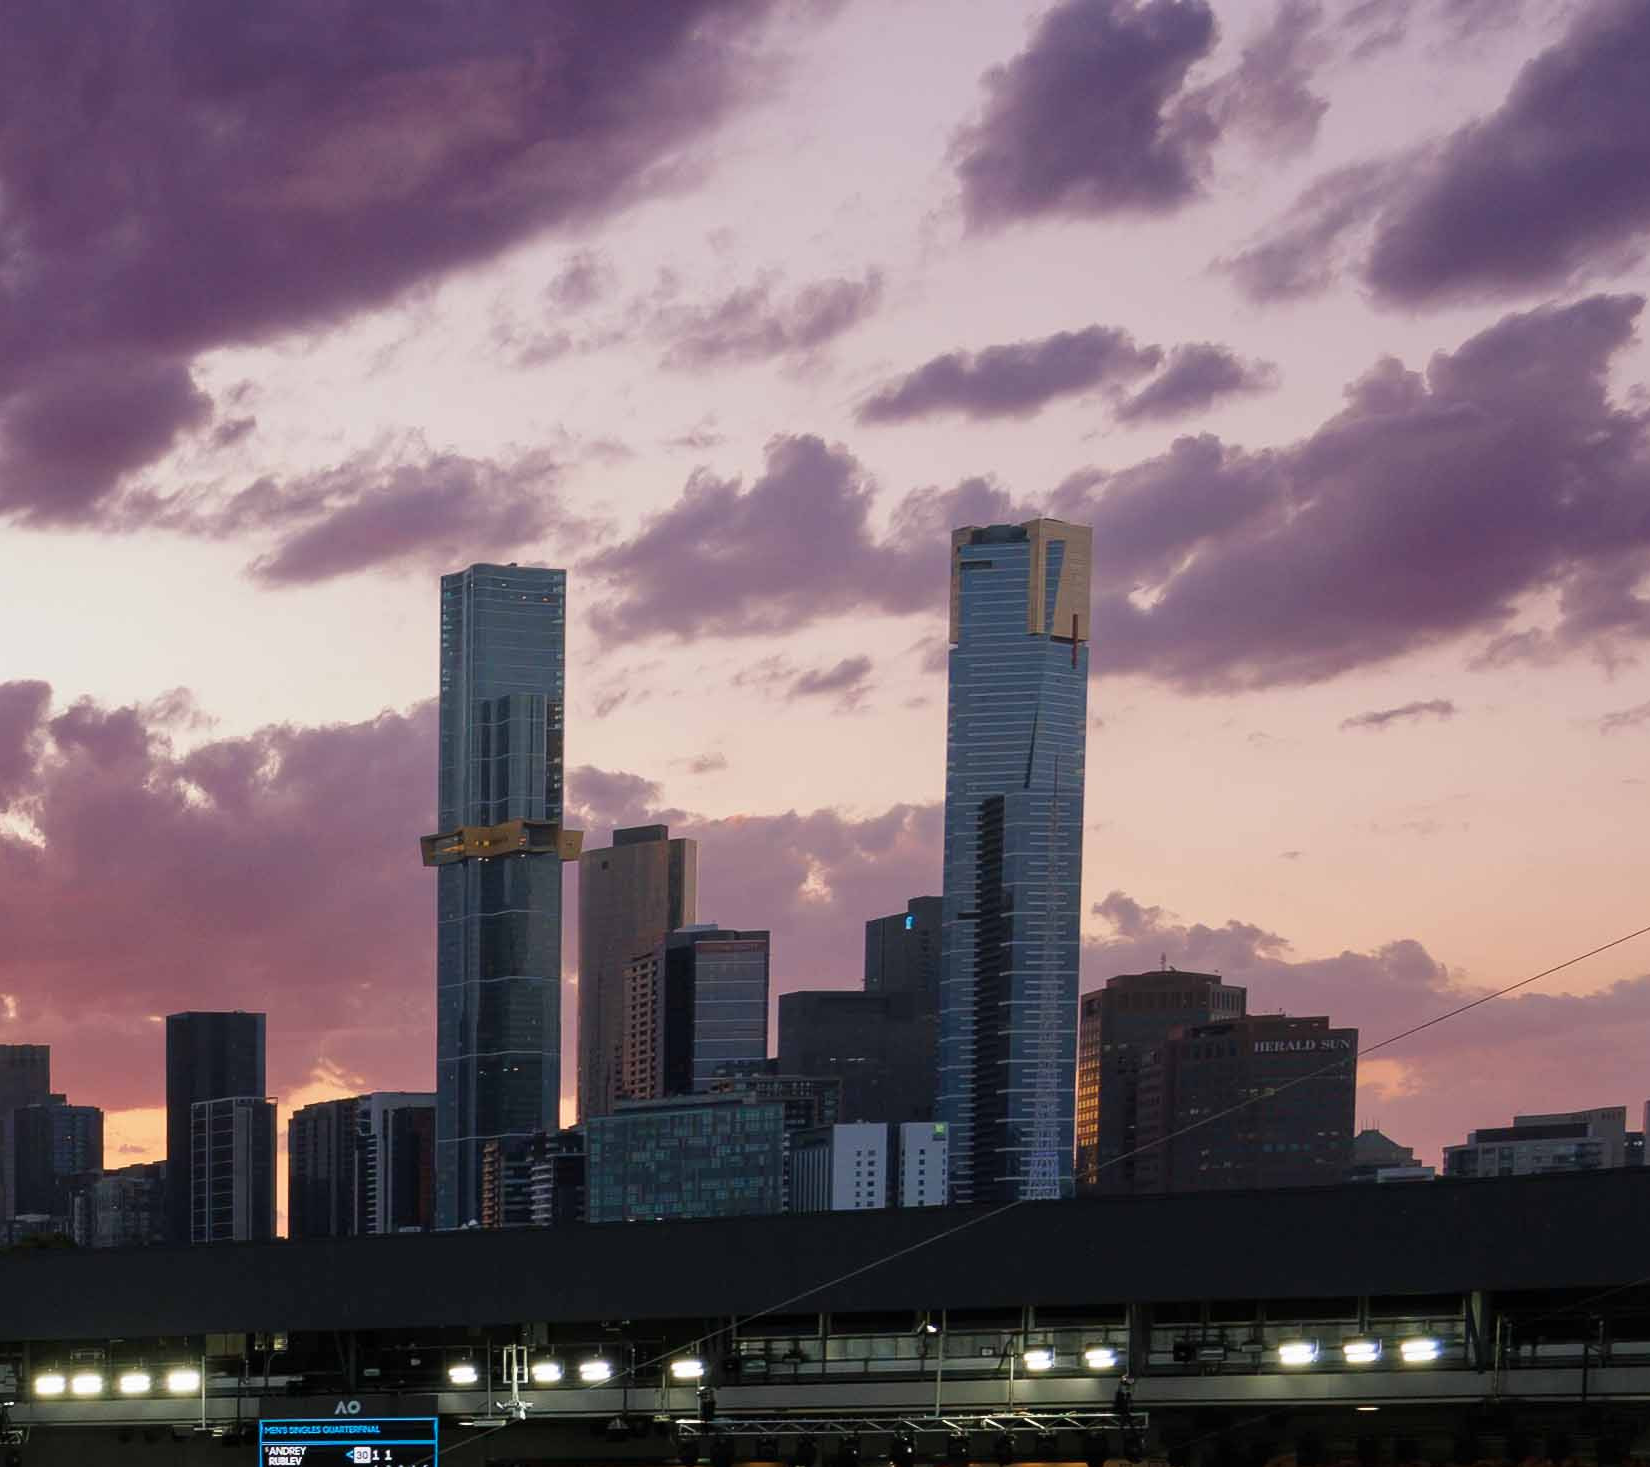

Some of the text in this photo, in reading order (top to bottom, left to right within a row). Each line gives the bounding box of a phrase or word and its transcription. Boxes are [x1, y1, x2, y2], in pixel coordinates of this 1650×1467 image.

[1254, 1039, 1351, 1053] HERALD SUN
[334, 1400, 362, 1415] AO
[289, 1426, 321, 1434] SINGLES
[322, 1424, 381, 1434] QUARTERFINAL
[268, 1447, 307, 1456] ANDREY
[356, 1450, 393, 1460] 30 1 1
[268, 1457, 302, 1466] RUBLEV
